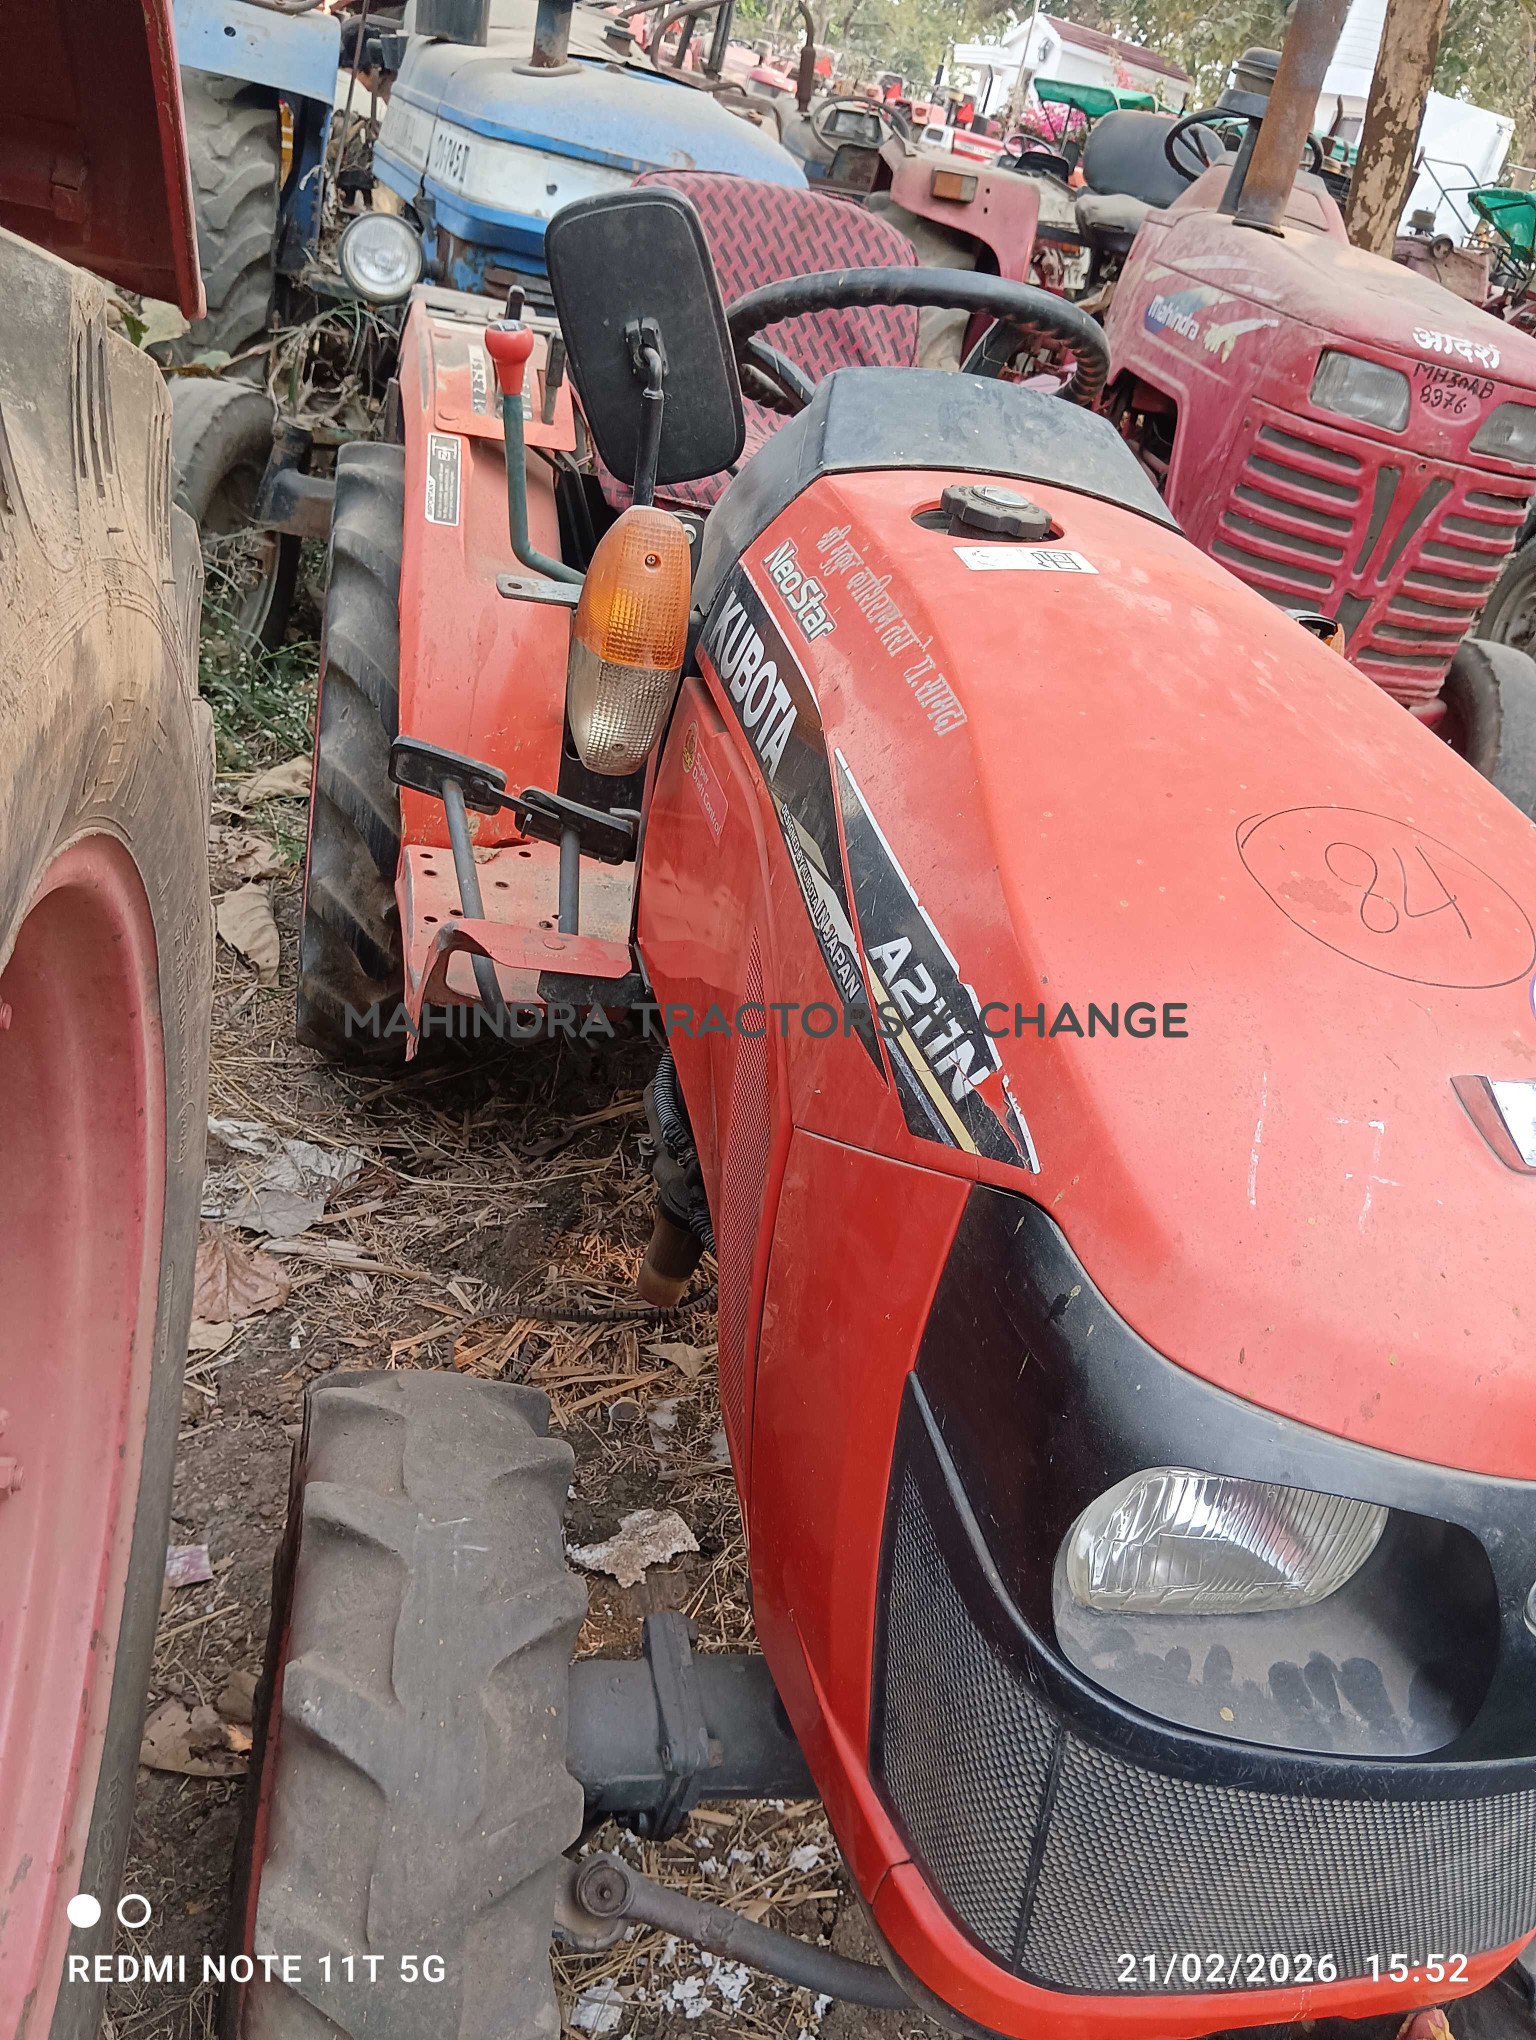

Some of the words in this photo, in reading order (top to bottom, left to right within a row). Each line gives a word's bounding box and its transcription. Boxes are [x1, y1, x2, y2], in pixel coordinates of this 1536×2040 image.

[1411, 326, 1502, 370] आदर्श
[816, 524, 852, 553] श्री
[763, 540, 835, 642] NeoStar
[707, 590, 799, 784] KUBOTA
[781, 802, 801, 855] DESIGNED
[800, 862, 819, 909] KUBOTA
[814, 899, 831, 932] IN
[823, 925, 862, 1001] JAPAN
[1324, 841, 1474, 939] 84
